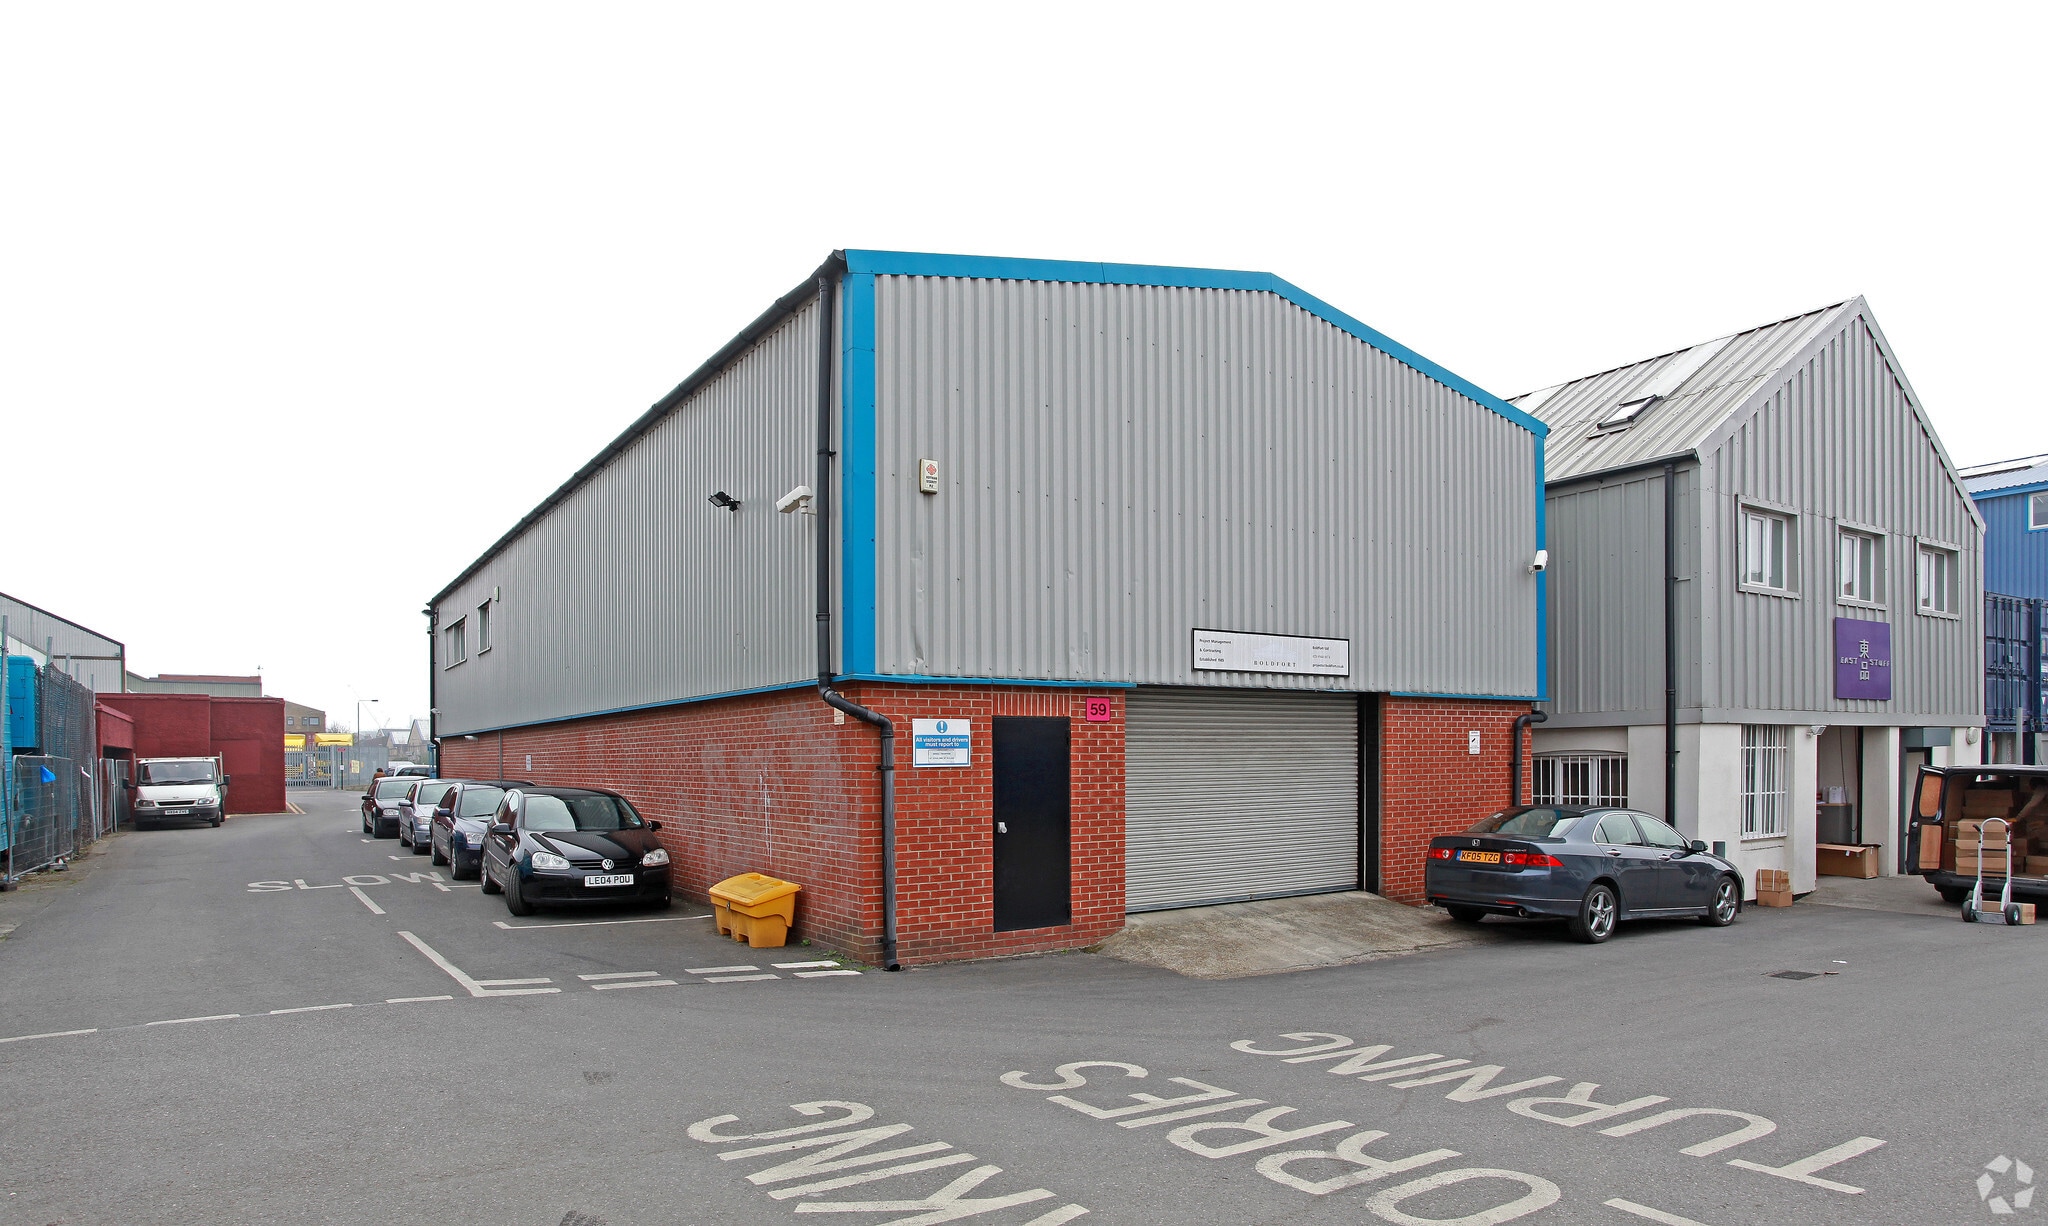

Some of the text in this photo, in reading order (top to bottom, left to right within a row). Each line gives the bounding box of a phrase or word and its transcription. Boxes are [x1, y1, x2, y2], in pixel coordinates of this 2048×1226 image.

[1253, 660, 1297, 668] BOLDFORT
[1840, 656, 1890, 667] EAST STUFF
[1090, 703, 1107, 716] 59
[1461, 852, 1499, 862] KF05 TZG
[247, 871, 446, 893] SLOW
[1230, 1031, 1888, 1195] TURNING
[1000, 1060, 1712, 1226] ORRIES
[686, 1100, 1090, 1226] KING
